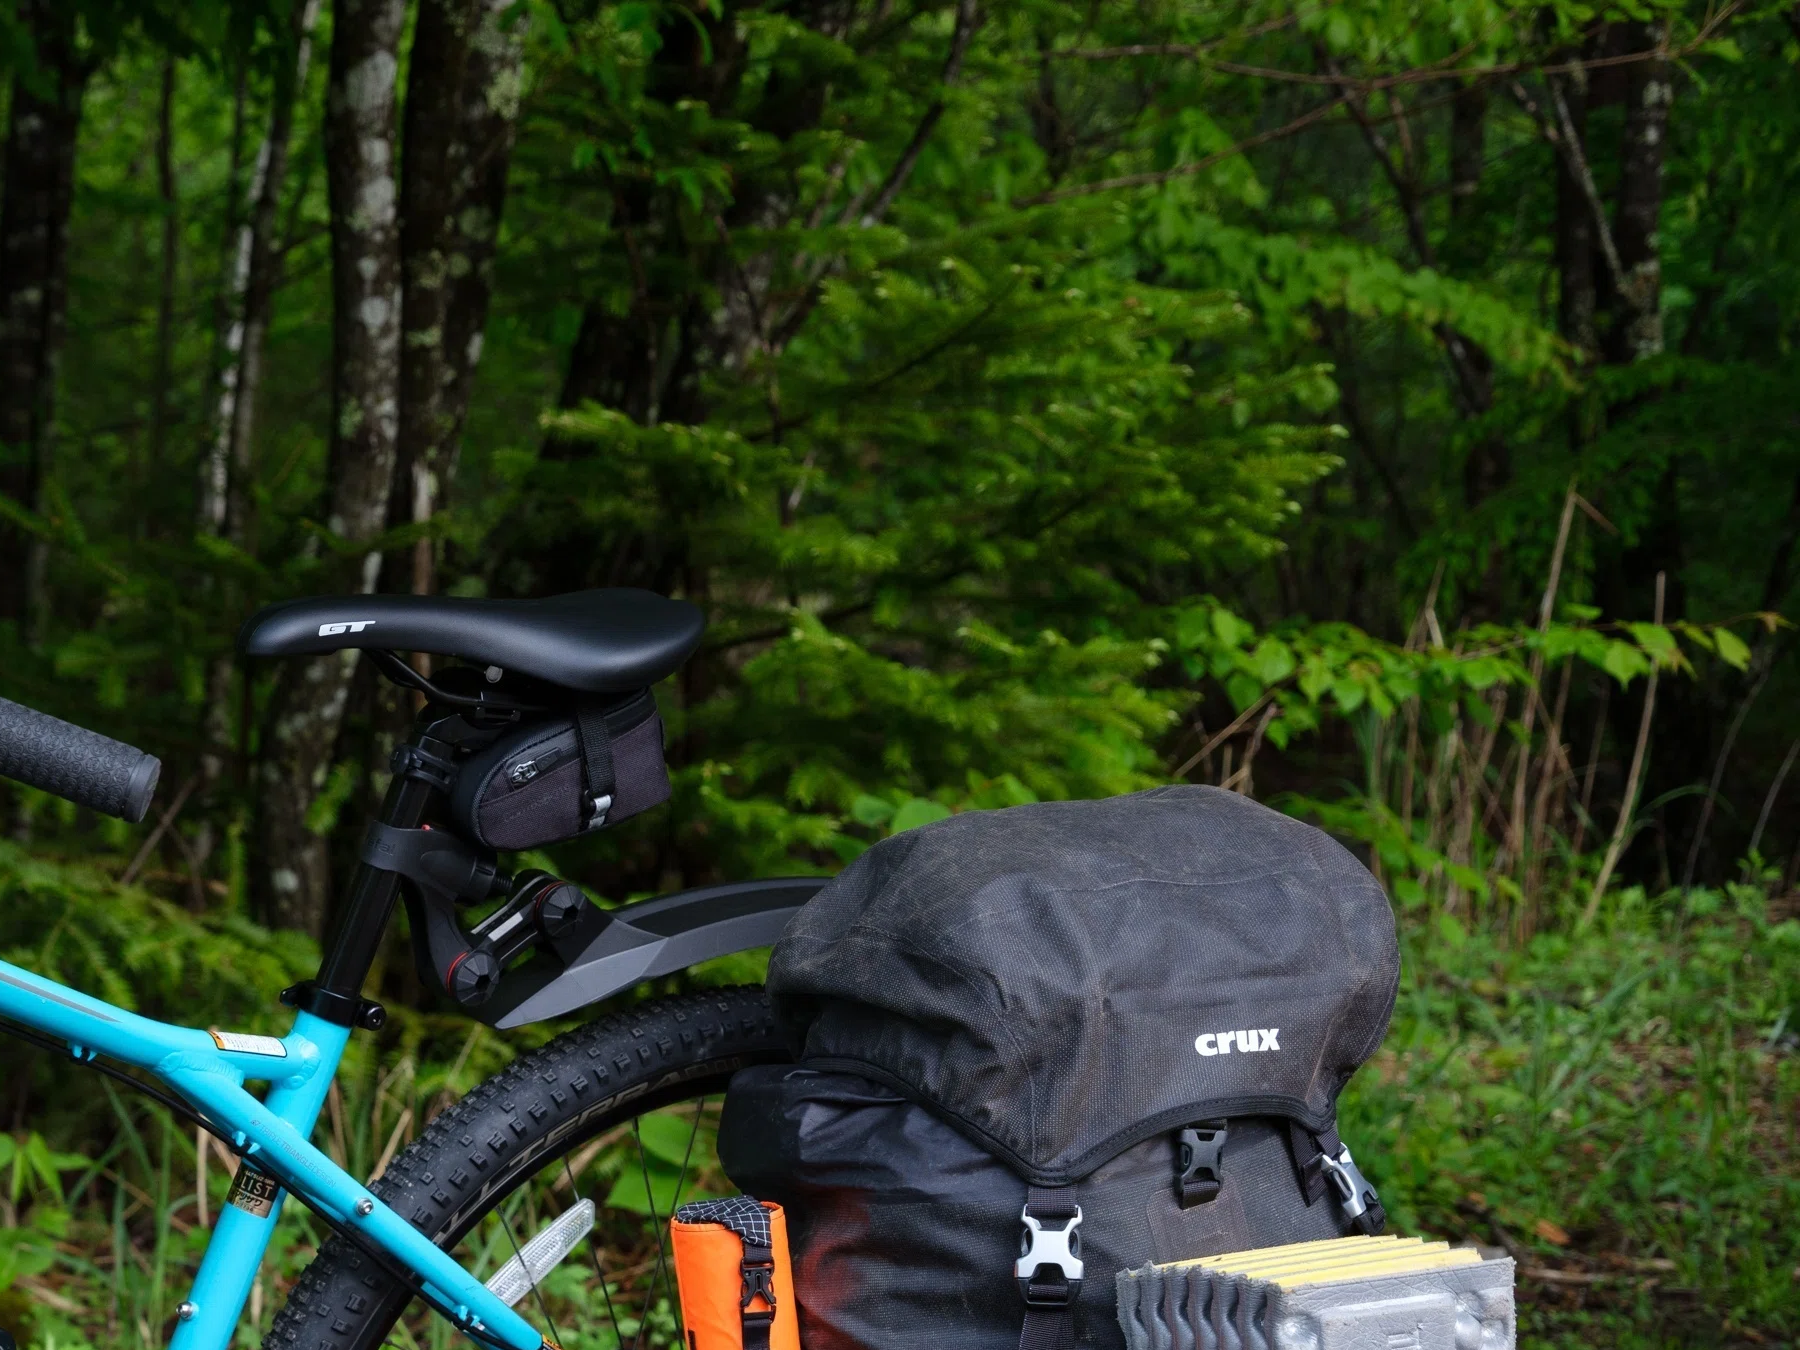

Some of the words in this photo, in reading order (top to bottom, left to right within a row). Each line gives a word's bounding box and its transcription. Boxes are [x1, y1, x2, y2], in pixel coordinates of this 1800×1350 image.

[319, 620, 376, 637] GT
[1195, 1028, 1280, 1057] crux
[280, 1140, 314, 1170] TRIANGLE
